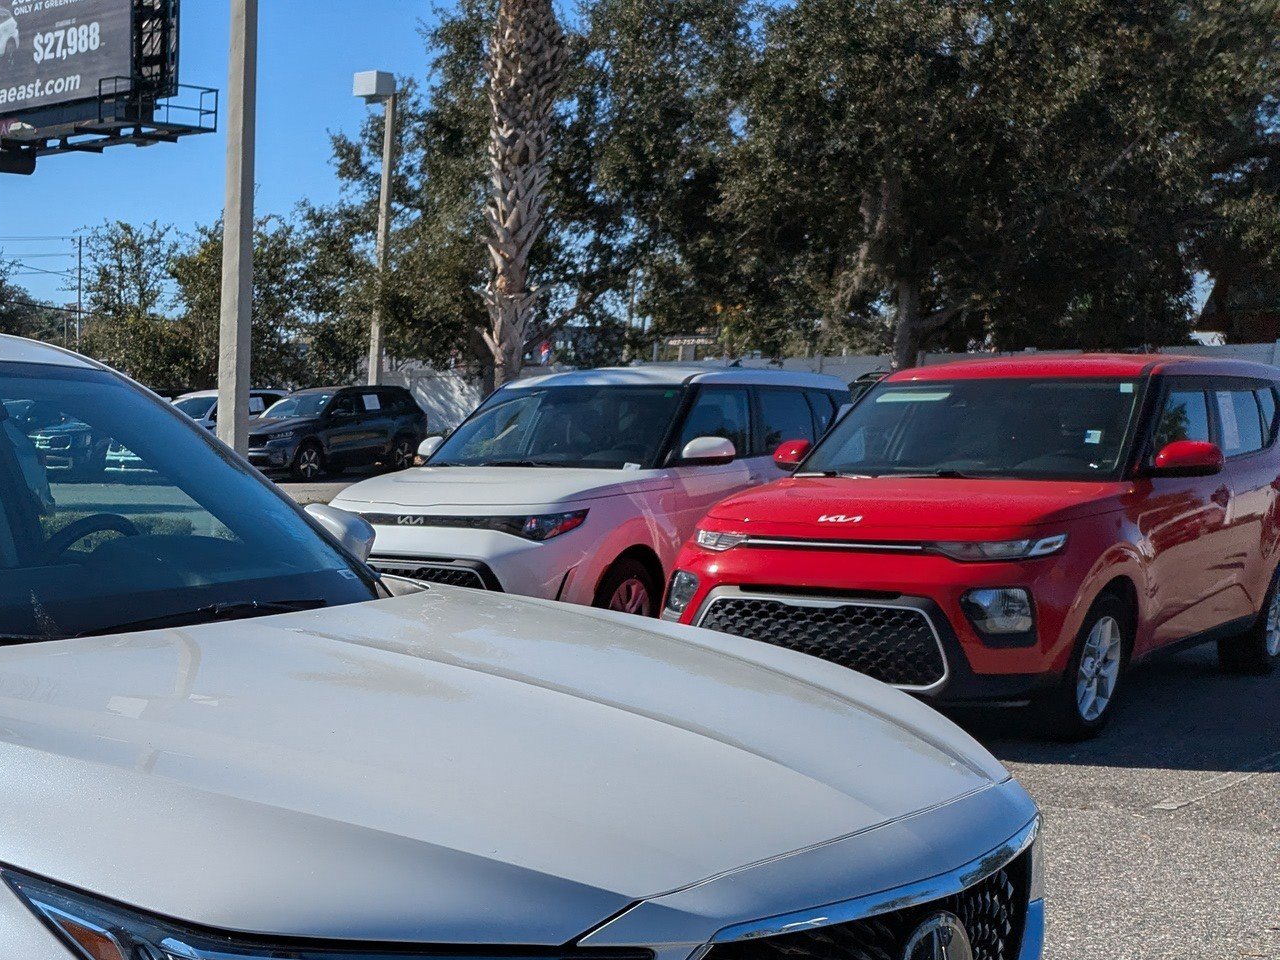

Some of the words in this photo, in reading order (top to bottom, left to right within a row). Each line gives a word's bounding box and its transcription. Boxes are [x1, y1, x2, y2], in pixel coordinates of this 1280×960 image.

[13, 5, 33, 16] ONLY
[33, 2, 43, 12] AT
[32, 22, 100, 64] $27,988
